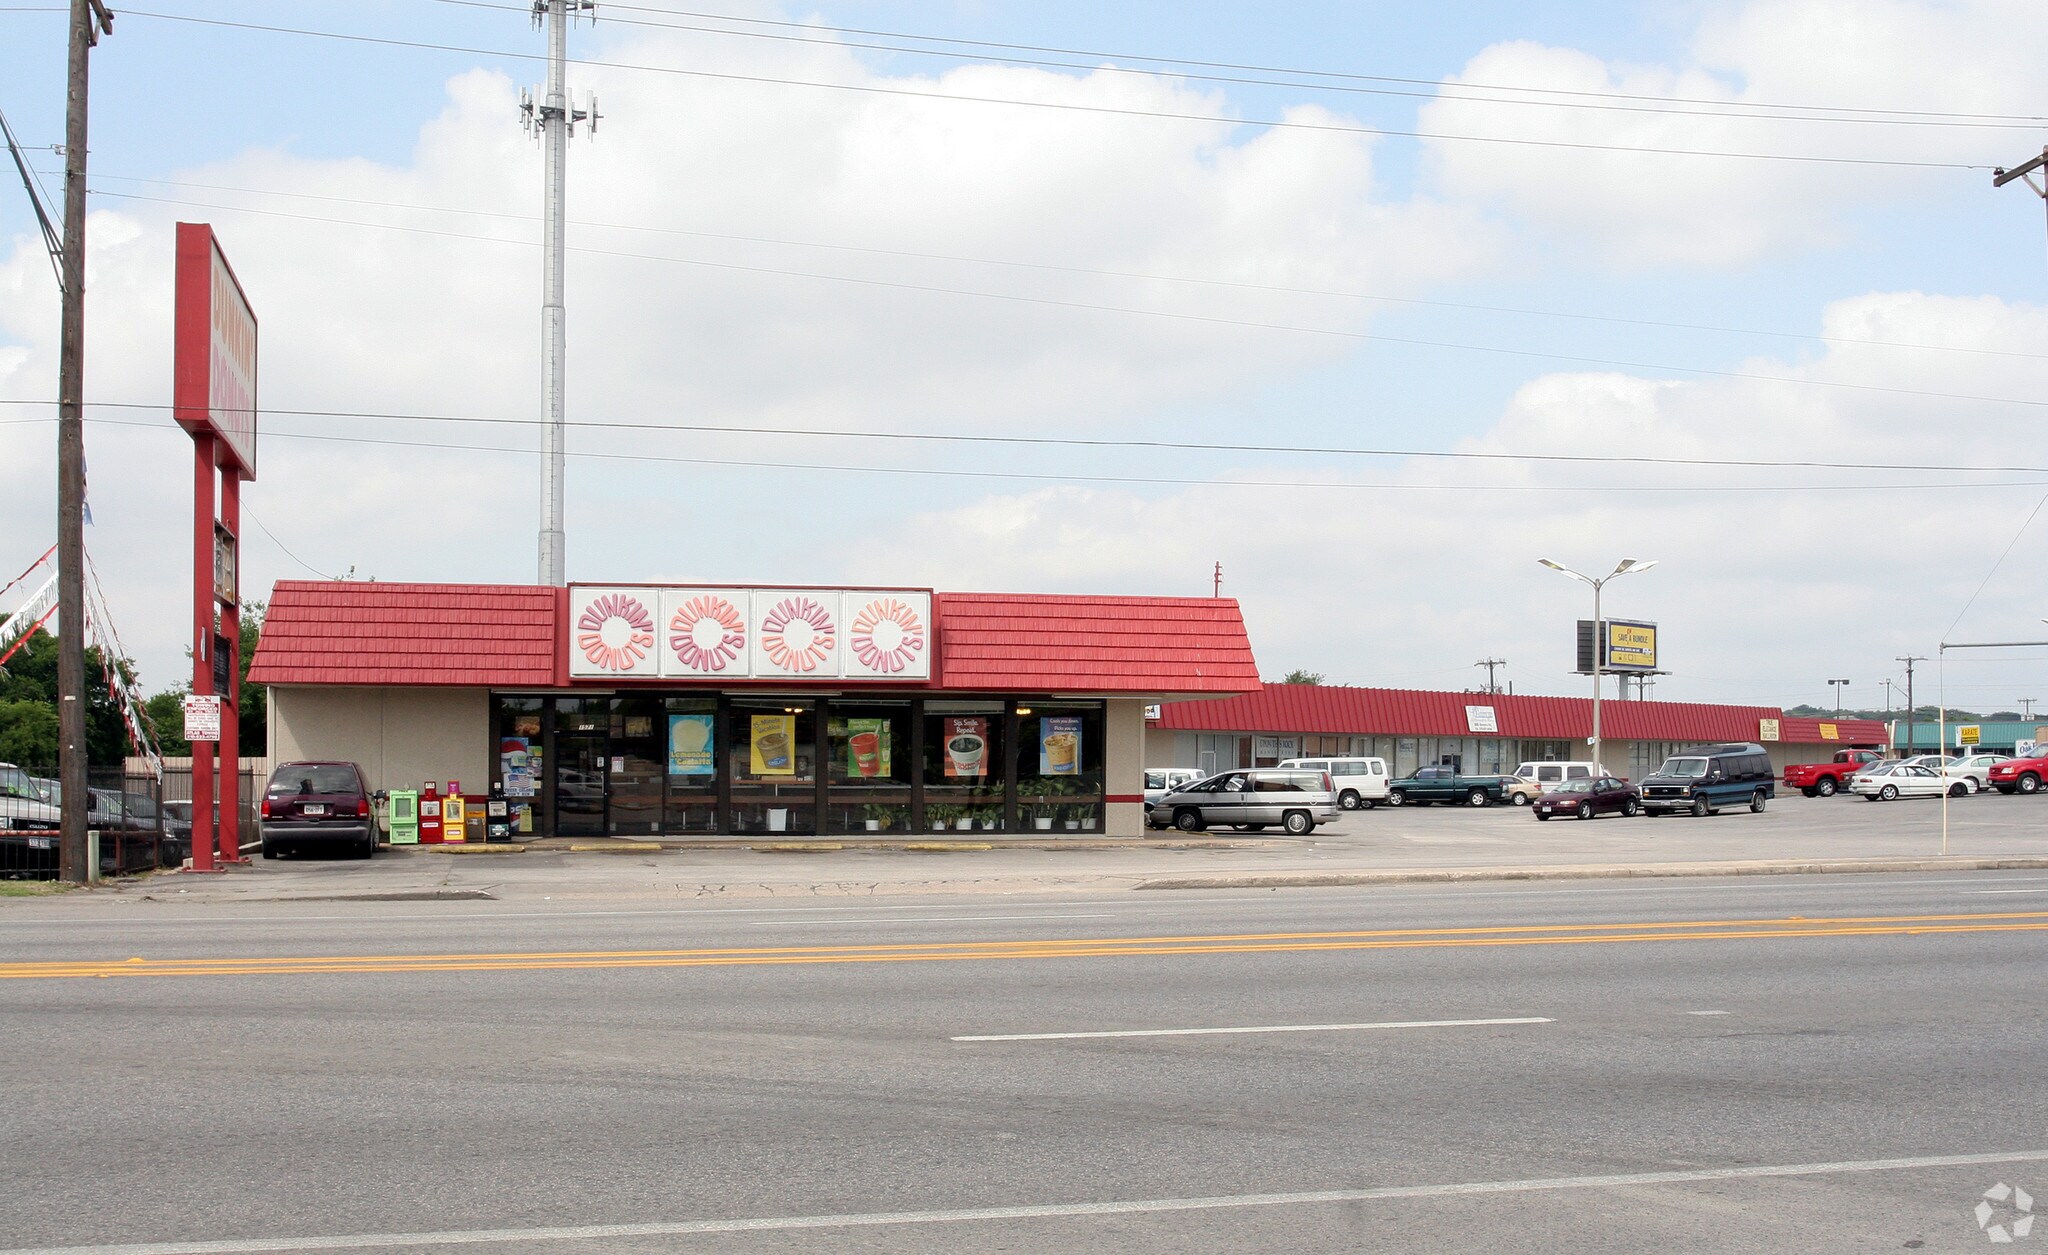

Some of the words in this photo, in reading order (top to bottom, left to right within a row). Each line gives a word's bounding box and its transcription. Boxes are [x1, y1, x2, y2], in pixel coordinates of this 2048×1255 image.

[578, 593, 654, 632] DUNKIN'
[669, 594, 746, 633] DUNKIN'
[761, 595, 836, 634] DUNKIN'
[851, 597, 924, 635] DUNKIN'
[578, 633, 654, 671] DONUTS
[669, 633, 745, 672] DONUTS
[761, 635, 836, 672] DONUTS
[850, 636, 924, 673] DONUTS
[1633, 634, 1648, 643] BUNDLE
[1962, 727, 1978, 736] KARATE
